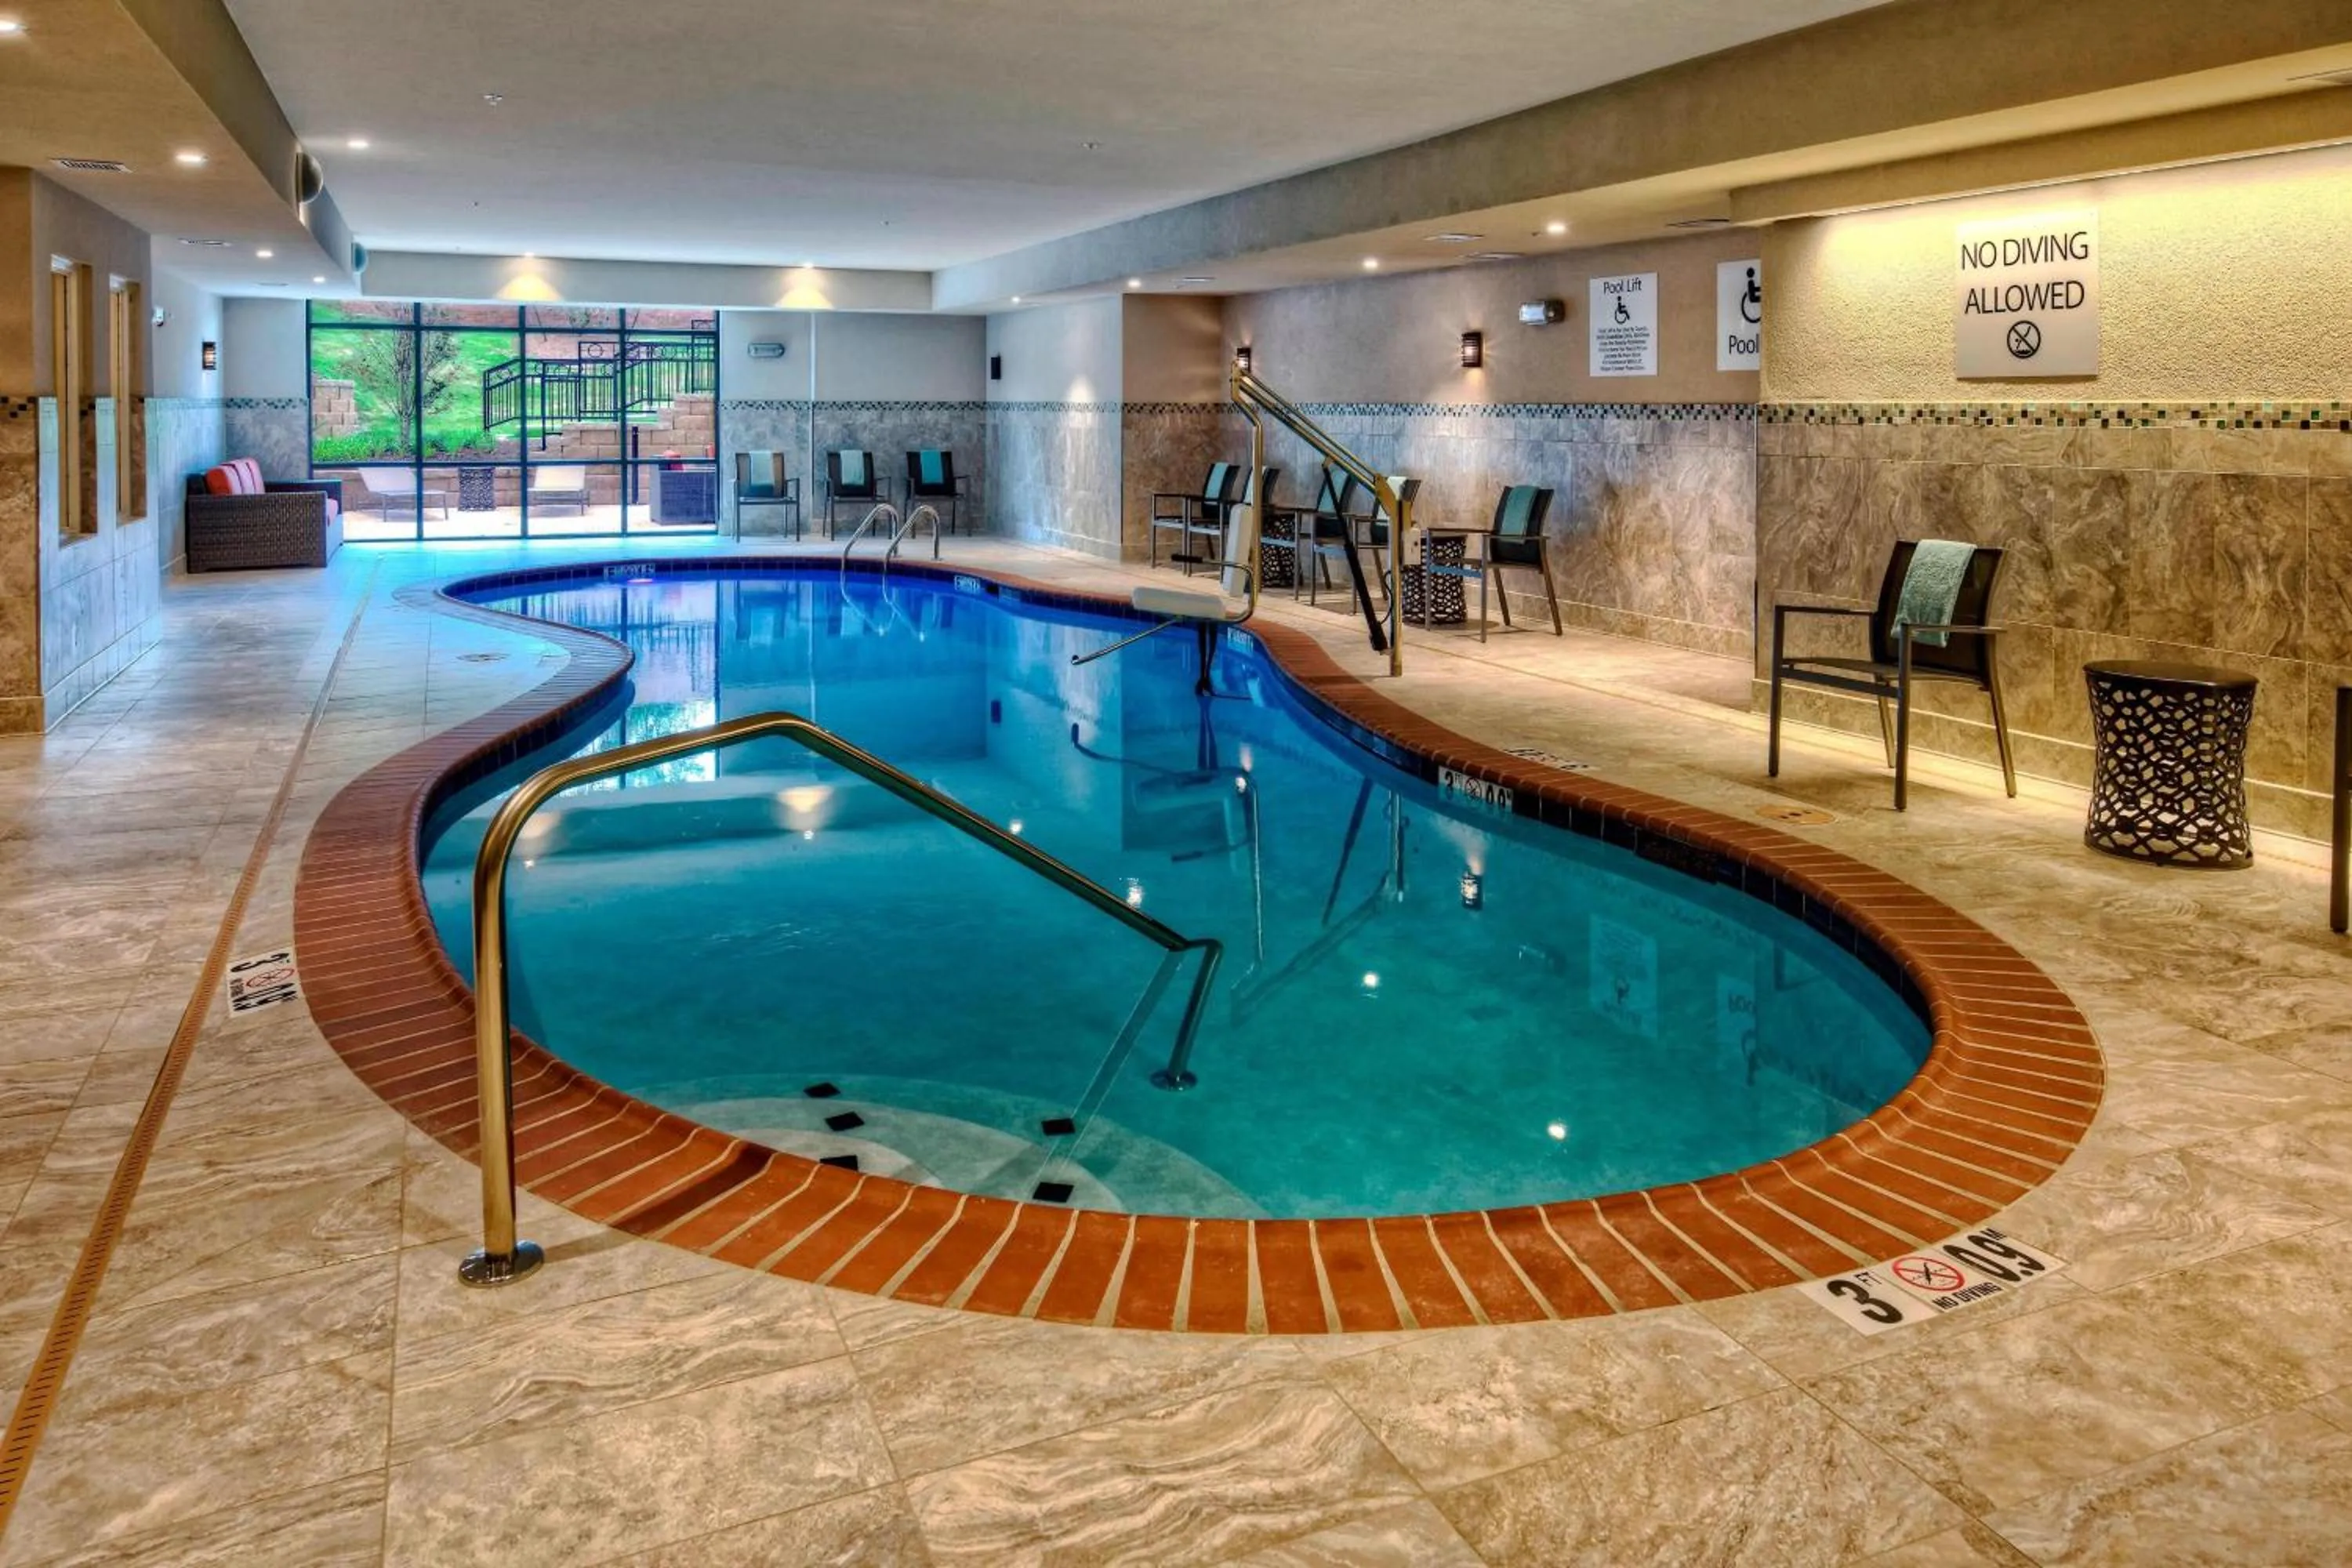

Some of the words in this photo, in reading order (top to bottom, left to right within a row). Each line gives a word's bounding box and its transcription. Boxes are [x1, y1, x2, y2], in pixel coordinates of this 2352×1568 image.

[1962, 241, 1997, 270] NO
[2003, 231, 2089, 266] DIVING
[1603, 279, 1623, 295] Pool
[1627, 277, 1642, 292] Lift
[1965, 281, 2085, 314] ALLOWED
[1729, 333, 1759, 354] Pool
[1980, 1228, 2007, 1240] M
[1943, 1235, 2045, 1282] 0.9
[1854, 1272, 1882, 1287] FT
[1828, 1279, 1904, 1324] 3
[1932, 1296, 1959, 1309] NO
[1952, 1282, 2002, 1302] DIVING
